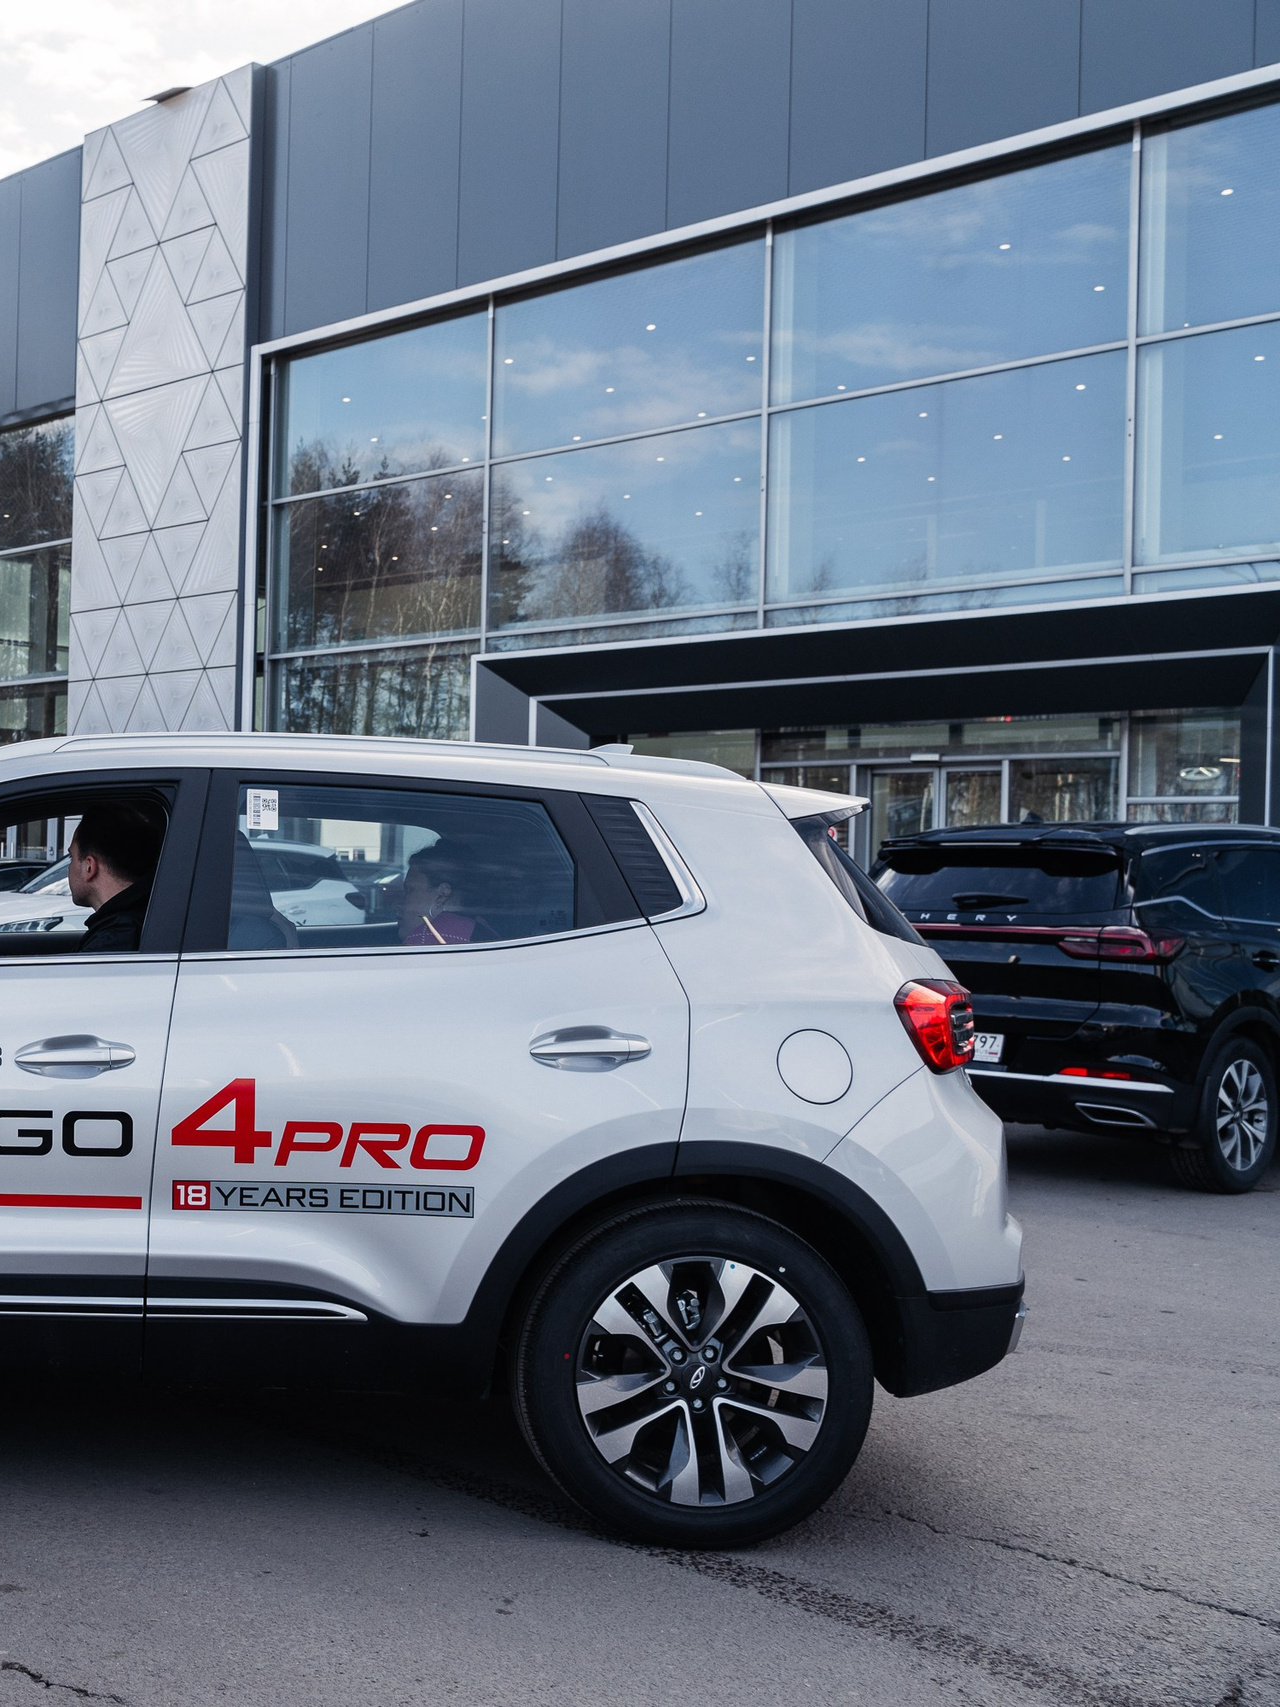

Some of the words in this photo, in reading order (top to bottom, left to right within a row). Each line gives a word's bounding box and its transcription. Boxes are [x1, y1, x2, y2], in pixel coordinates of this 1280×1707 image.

[901, 912, 1017, 922] HERY
[176, 1184, 207, 1206] 18
[215, 1186, 329, 1208] YEARS
[339, 1188, 471, 1213] EDITION
